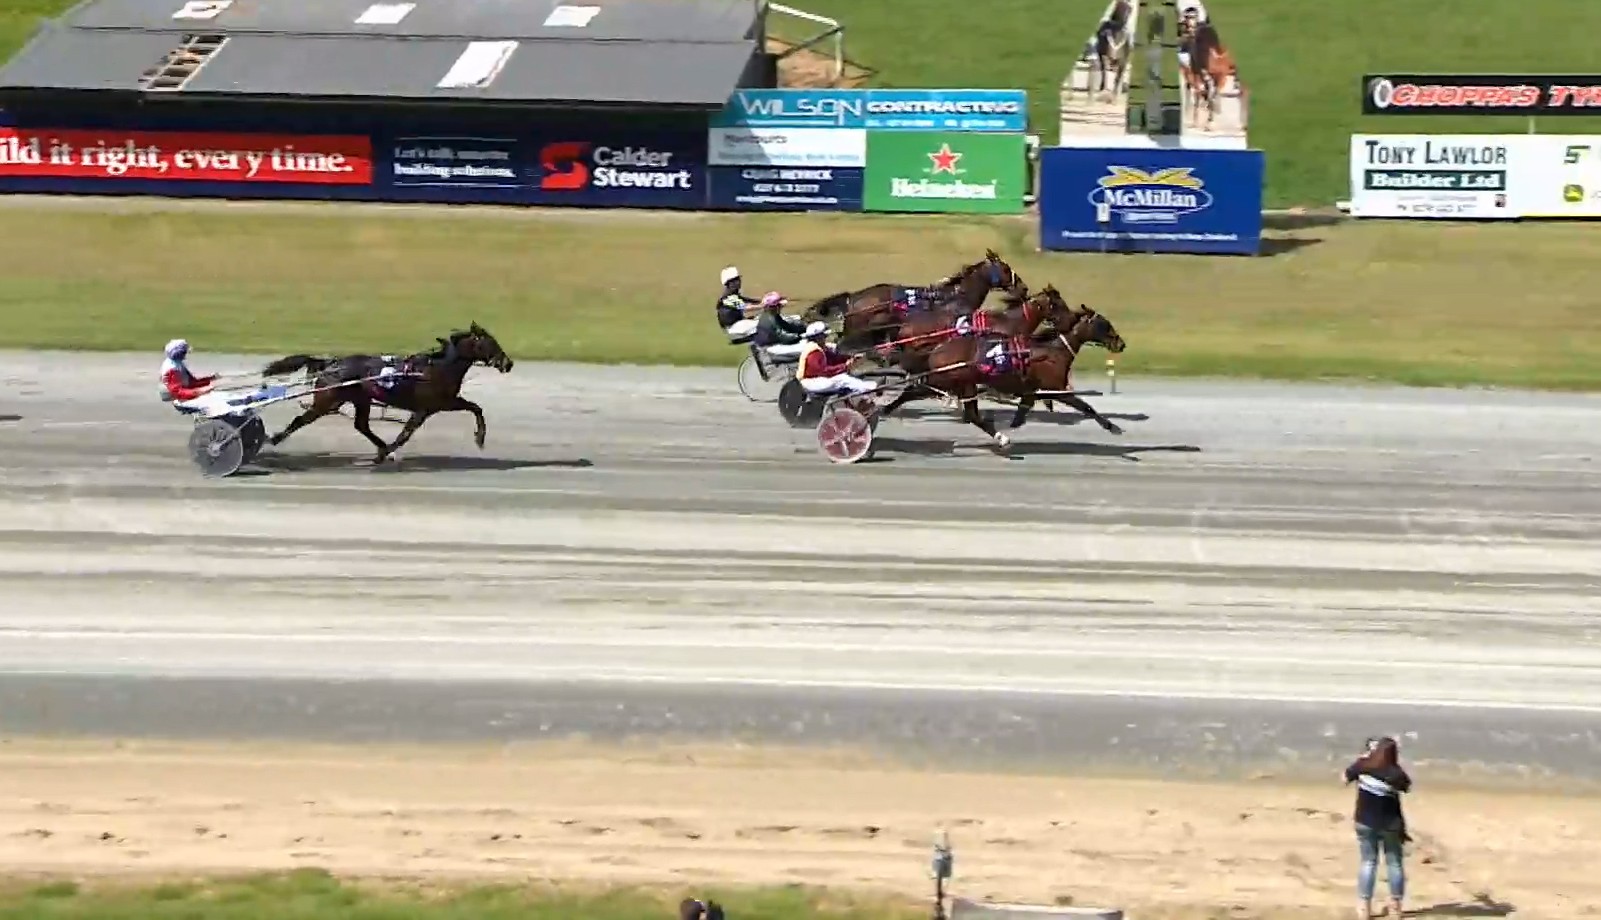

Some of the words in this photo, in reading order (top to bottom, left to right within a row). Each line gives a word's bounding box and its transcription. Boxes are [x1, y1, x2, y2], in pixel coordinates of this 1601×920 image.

[738, 93, 863, 127] WILSON
[866, 100, 1019, 115] CONTRACTING
[49, 137, 75, 166] it
[81, 139, 169, 175] right,
[174, 147, 264, 178] every
[270, 144, 354, 173] time.
[593, 146, 673, 167] Calder
[1365, 140, 1417, 164] TONY
[1424, 140, 1508, 165] LAWLOR
[593, 166, 691, 189] Stewart
[890, 177, 998, 199] Heineken
[1371, 173, 1457, 188] Builder
[1460, 172, 1500, 188] Ltd
[1103, 188, 1197, 208] McMillan
